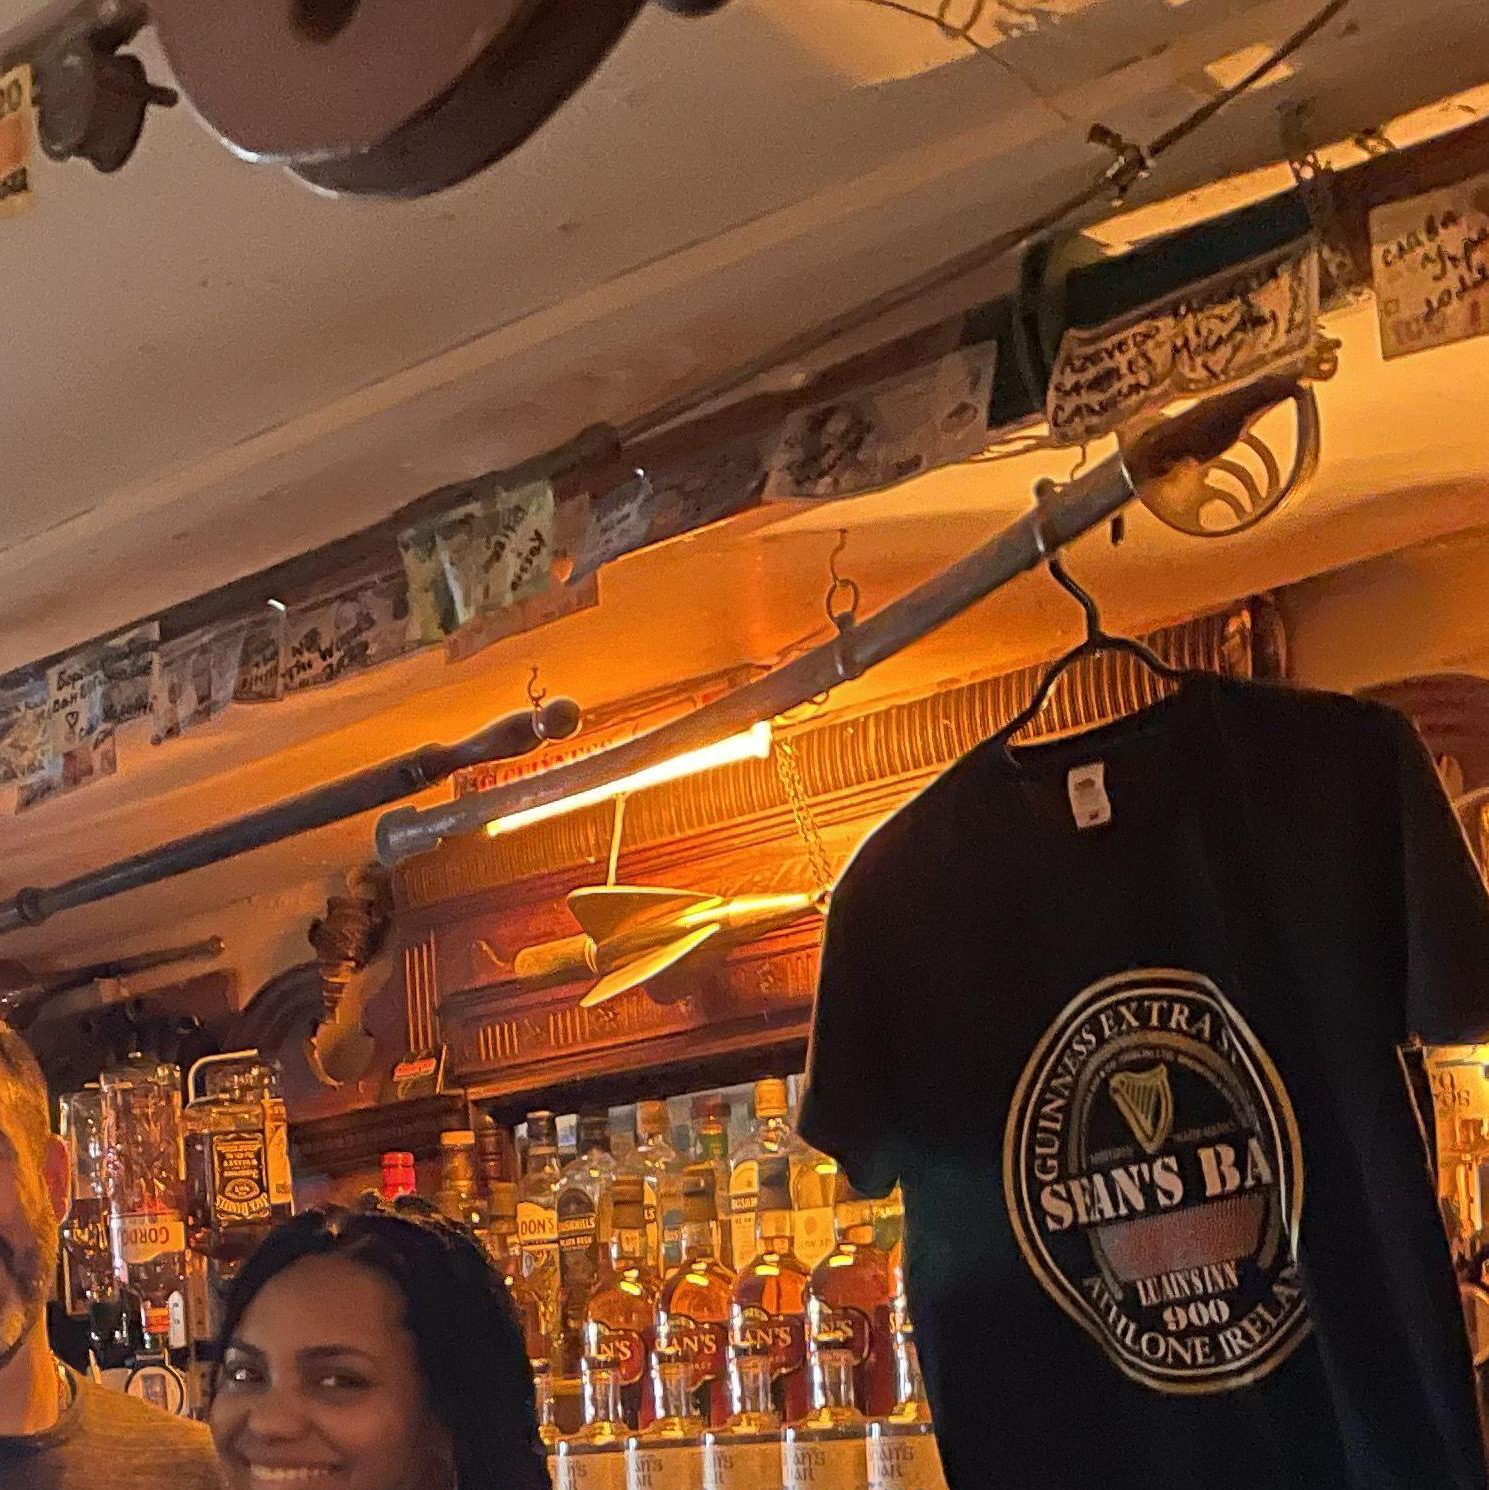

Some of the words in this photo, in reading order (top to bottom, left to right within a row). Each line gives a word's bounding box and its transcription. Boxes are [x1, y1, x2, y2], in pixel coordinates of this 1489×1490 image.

[1034, 1023, 1097, 1183] GUINNESS
[1099, 999, 1212, 1039] EXTRA
[1040, 1154, 1185, 1232] SEAN'S
[1197, 1137, 1274, 1198] BA
[520, 1217, 555, 1236] DON'S
[1163, 1298, 1230, 1332] 900
